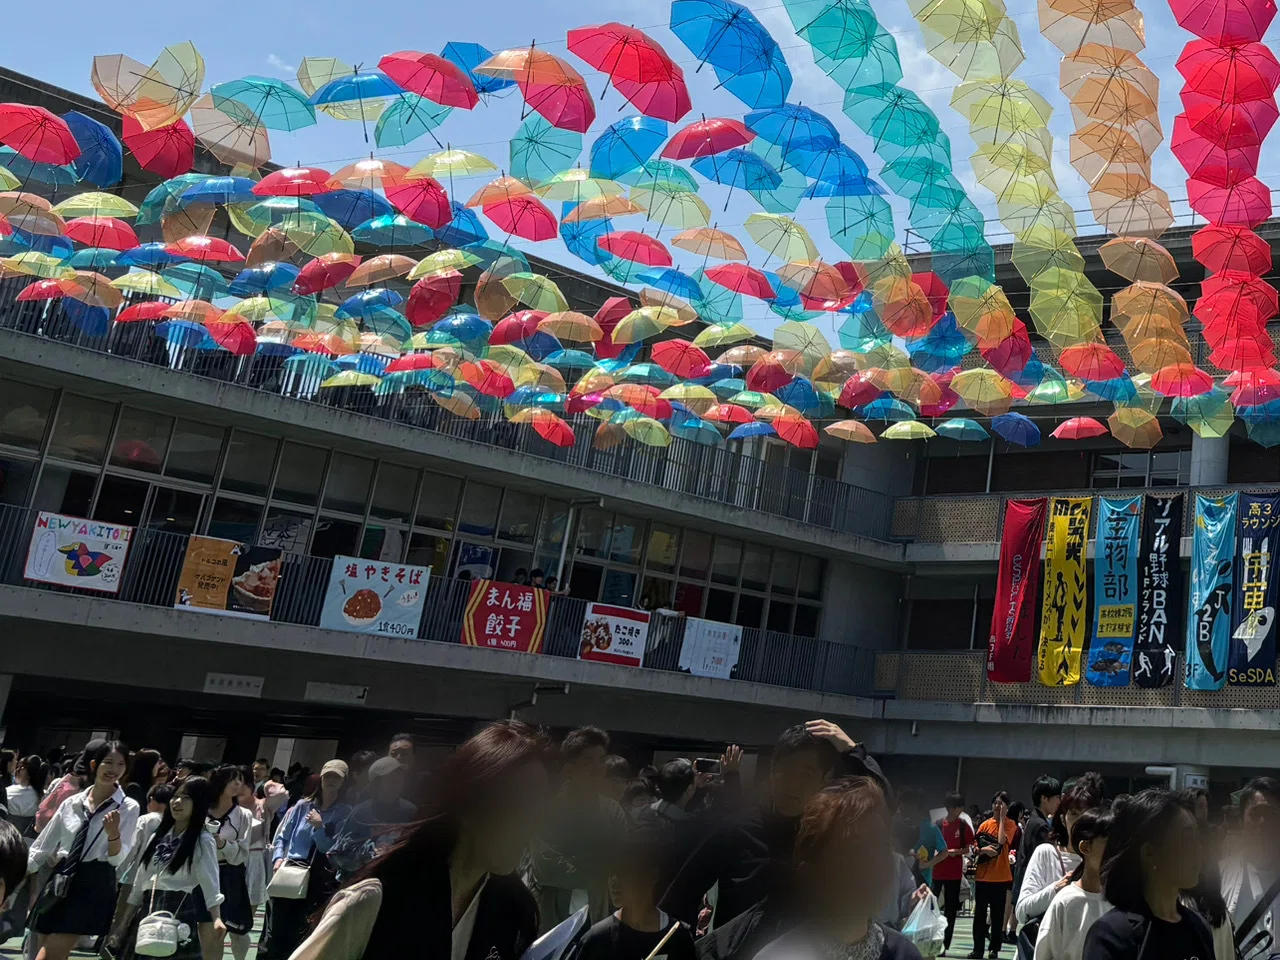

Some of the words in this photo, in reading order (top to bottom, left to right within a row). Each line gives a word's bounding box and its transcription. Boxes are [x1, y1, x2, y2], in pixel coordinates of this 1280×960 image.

[1248, 503, 1272, 516] 高3
[1242, 515, 1280, 529] ラウンジ
[1103, 509, 1129, 602] 生物部
[345, 563, 423, 585] 塩やきそば
[486, 587, 534, 611] まん福
[485, 612, 522, 637] 餃子
[1229, 668, 1275, 684] SeSDA
